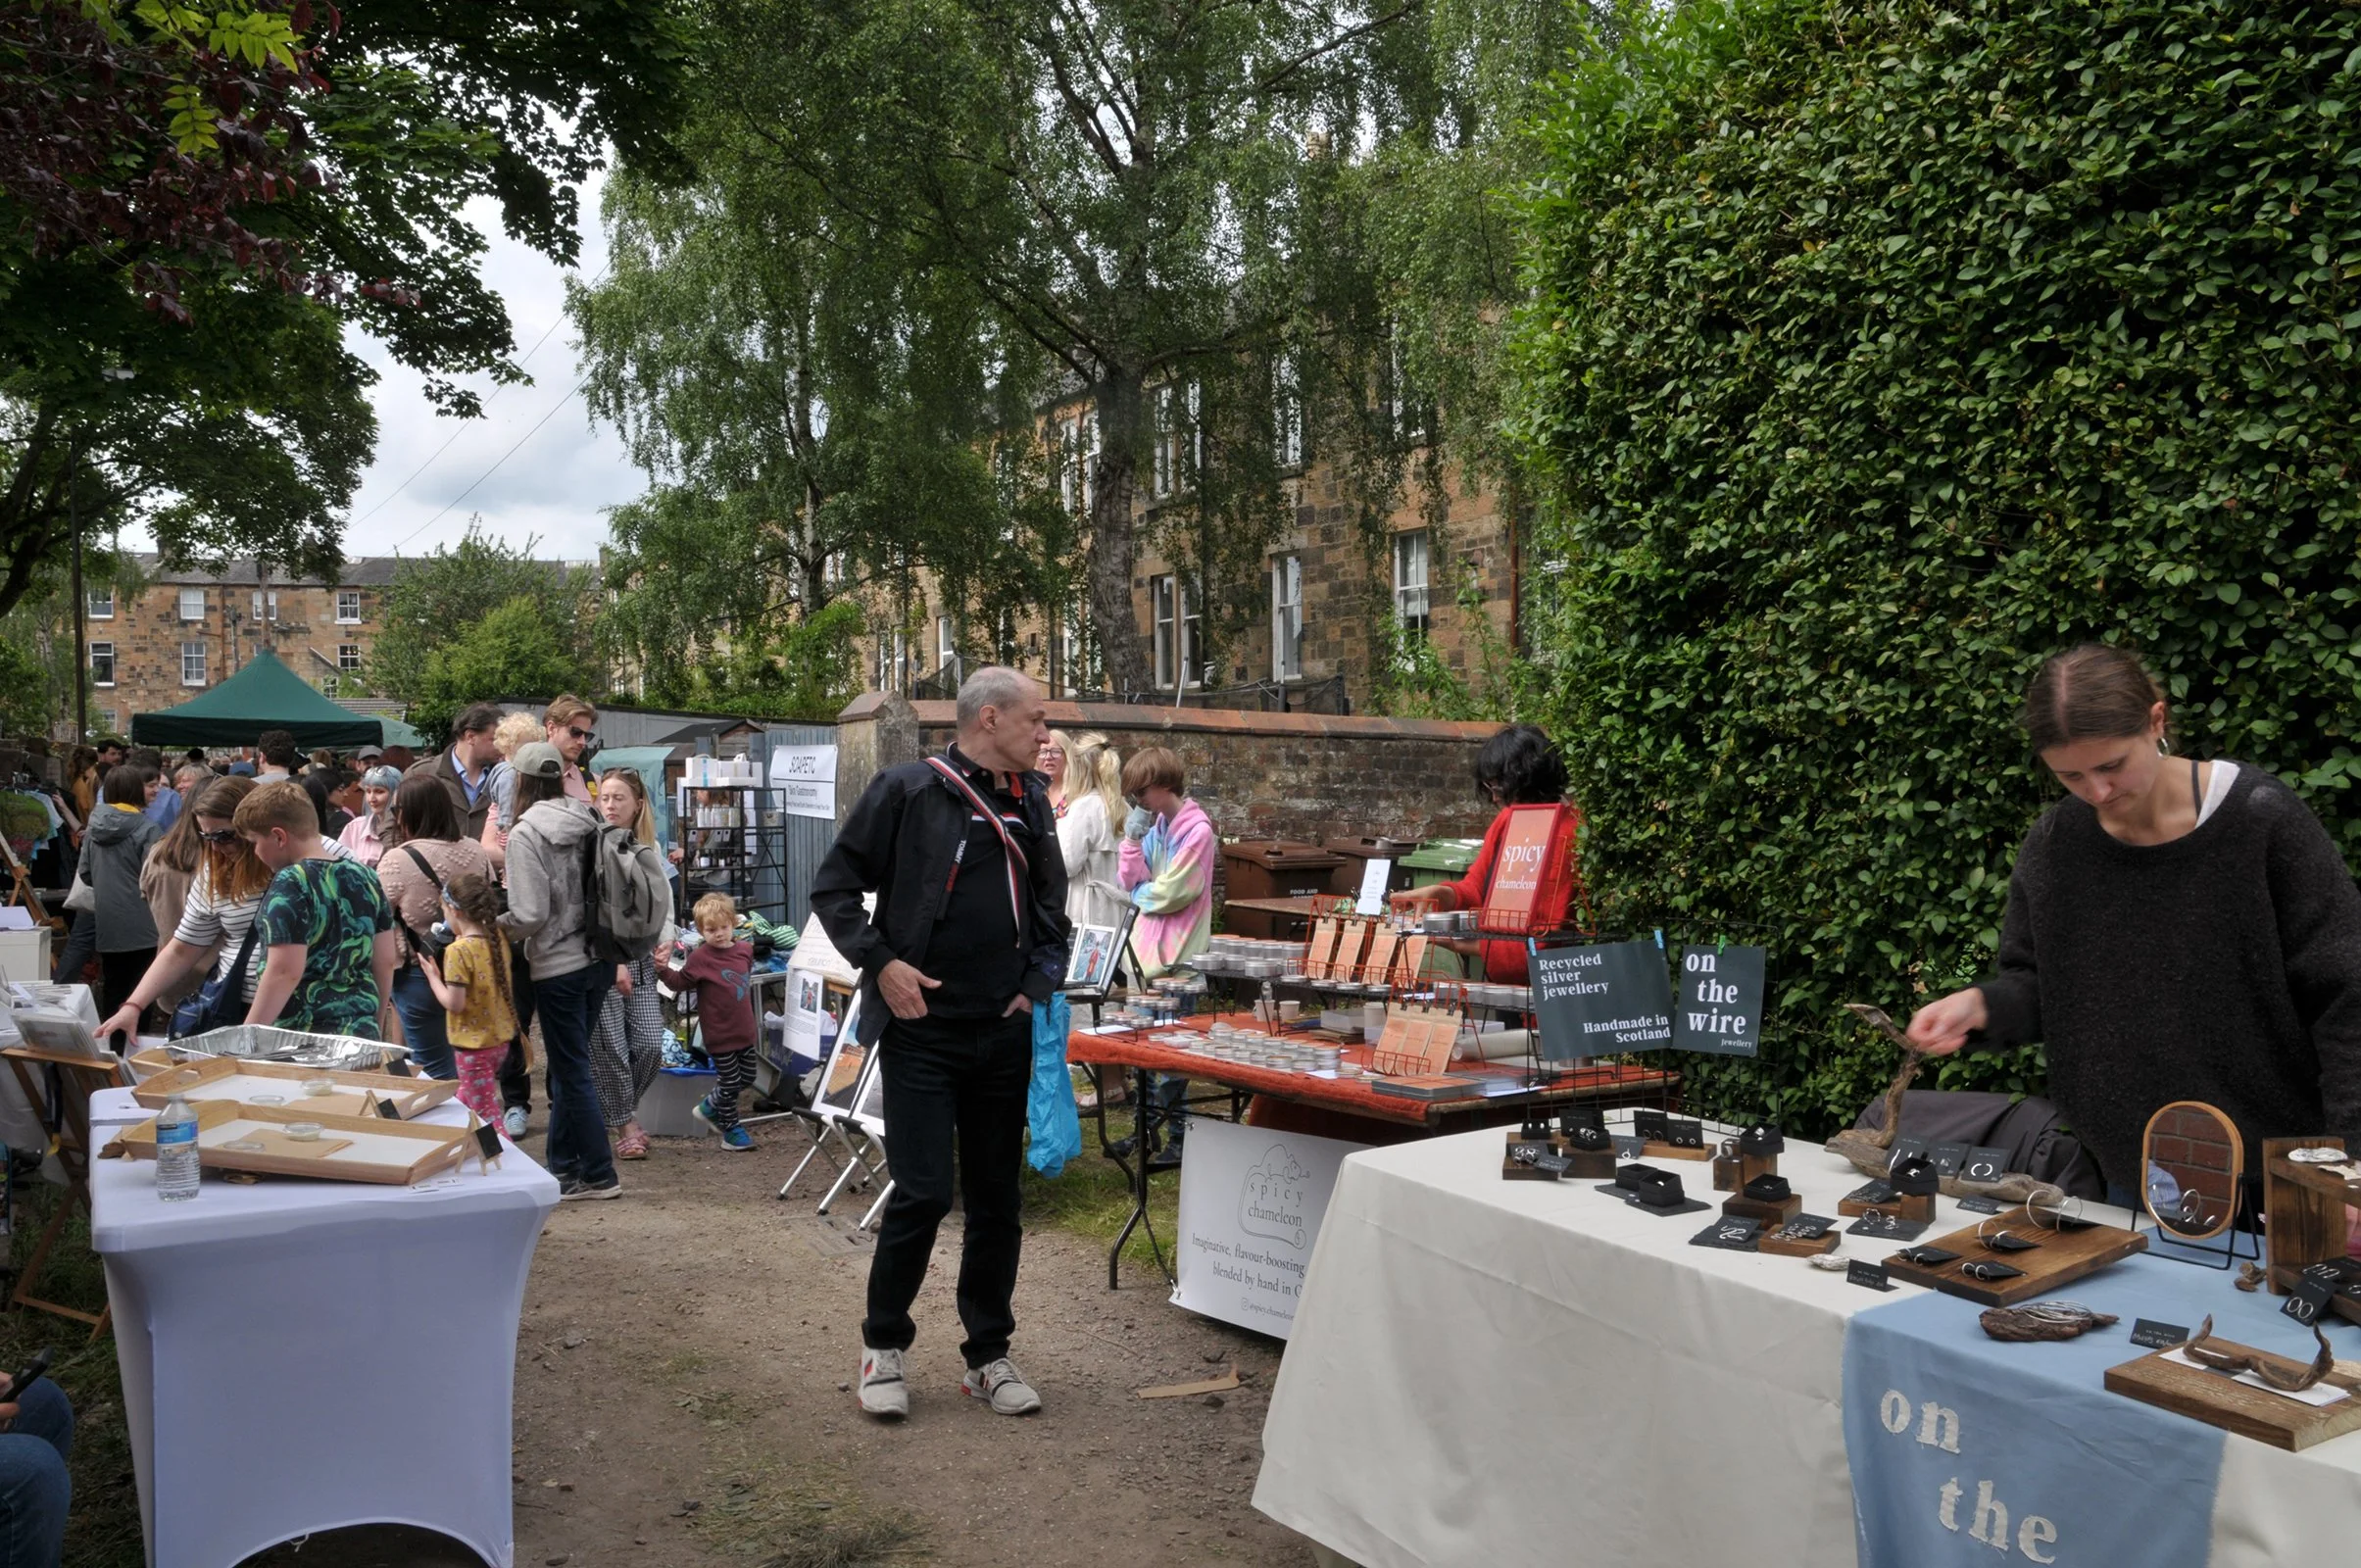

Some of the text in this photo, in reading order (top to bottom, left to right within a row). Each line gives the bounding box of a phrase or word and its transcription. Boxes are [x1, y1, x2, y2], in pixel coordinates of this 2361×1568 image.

[789, 757, 816, 774] SOAPETC
[955, 840, 966, 863] TOMMY
[1502, 837, 1547, 873] spicy
[1496, 875, 1537, 890] chameleon
[1539, 953, 1602, 972] Recycled
[1686, 953, 1716, 973] on
[1541, 968, 1581, 985] silver
[1543, 980, 1609, 1001] jewellery
[1697, 978, 1739, 1004] the
[1583, 1013, 1669, 1034] Handmade in
[1688, 1007, 1747, 1035] wire
[1615, 1026, 1672, 1044] Scotland
[1250, 1182, 1303, 1208] spicy
[1248, 1200, 1303, 1227] chameleon
[1192, 1232, 1305, 1278] Imaginative, flavour-boosting
[1212, 1261, 1243, 1283] blended
[1245, 1269, 1255, 1290] by
[1257, 1274, 1279, 1293] hand
[1282, 1281, 1291, 1296] in
[1881, 1388, 1960, 1453] on
[1939, 1477, 2057, 1564] the
